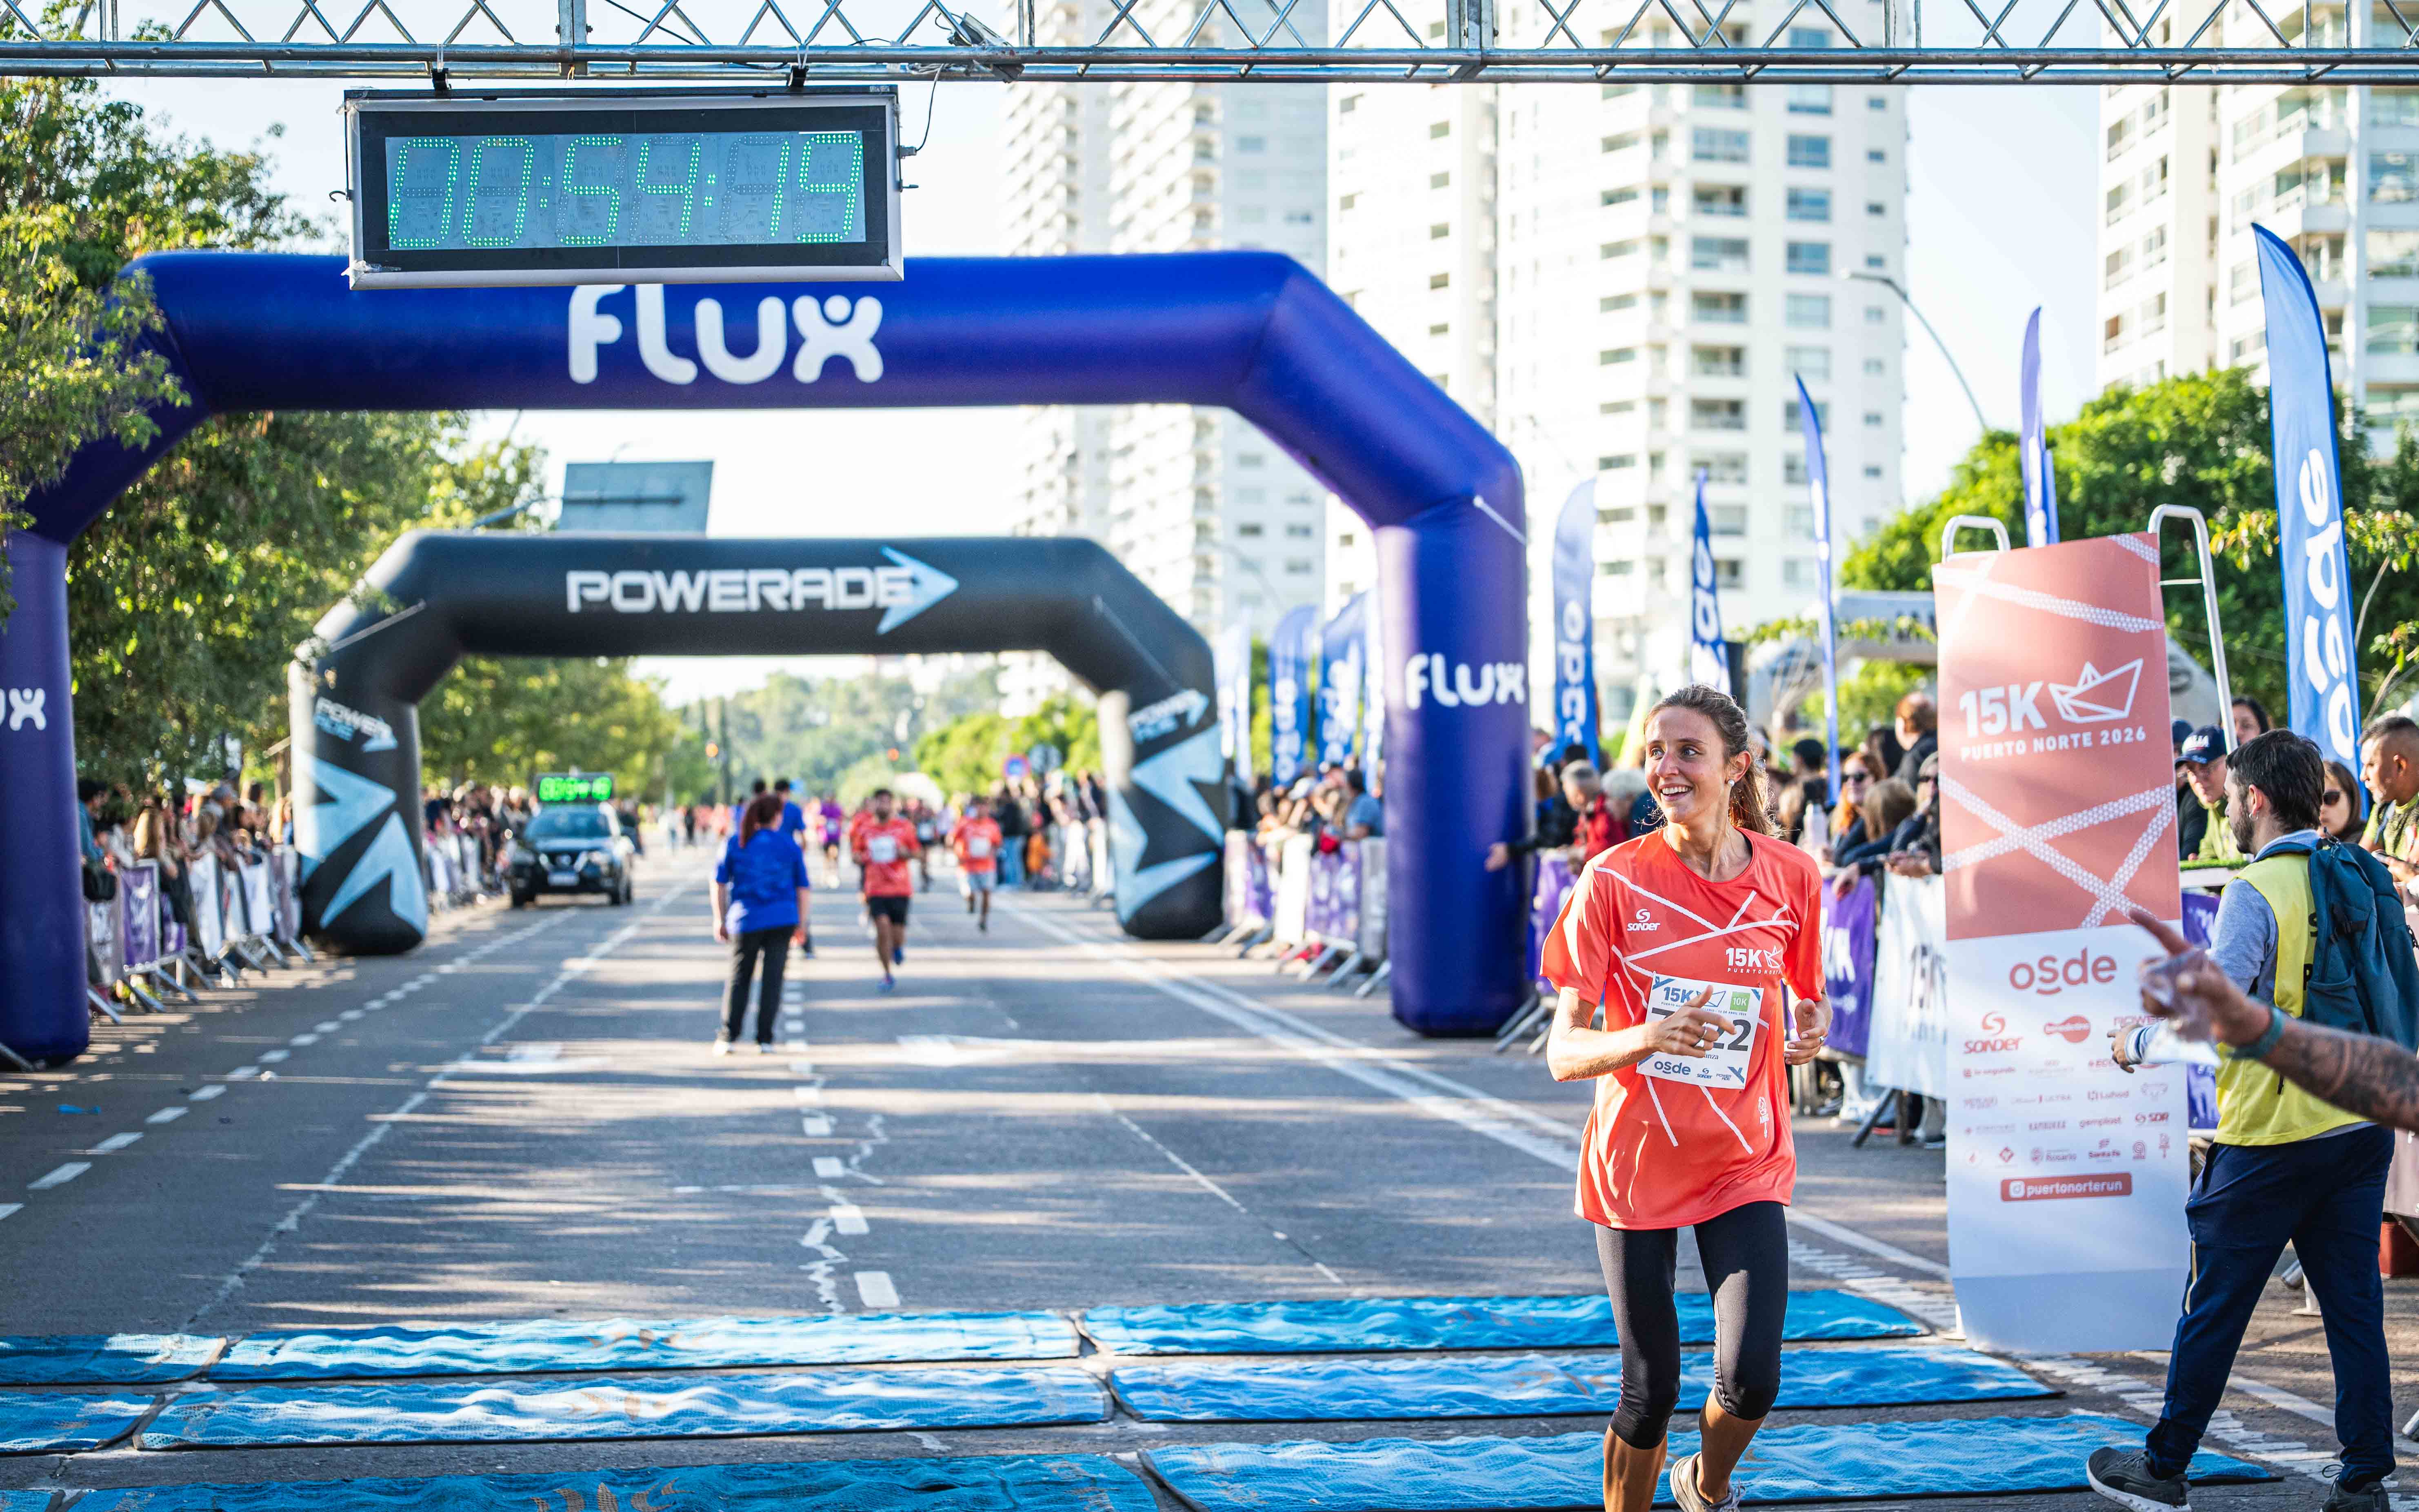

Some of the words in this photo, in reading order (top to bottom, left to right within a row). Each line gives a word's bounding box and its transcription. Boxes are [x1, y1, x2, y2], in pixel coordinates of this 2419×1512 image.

[389, 135, 863, 246] 00:54:19
[566, 568, 914, 613] POWERADE
[1959, 680, 2048, 738] 15K
[1960, 739, 2027, 762] PUERTO
[2033, 732, 2093, 753] NORTE
[2100, 726, 2147, 746] 2026
[1726, 947, 1763, 967] 15K
[2010, 946, 2117, 995] osde
[1664, 986, 1693, 1003] 15K
[1733, 997, 1747, 1006] 10K
[1654, 1061, 1691, 1075] osde
